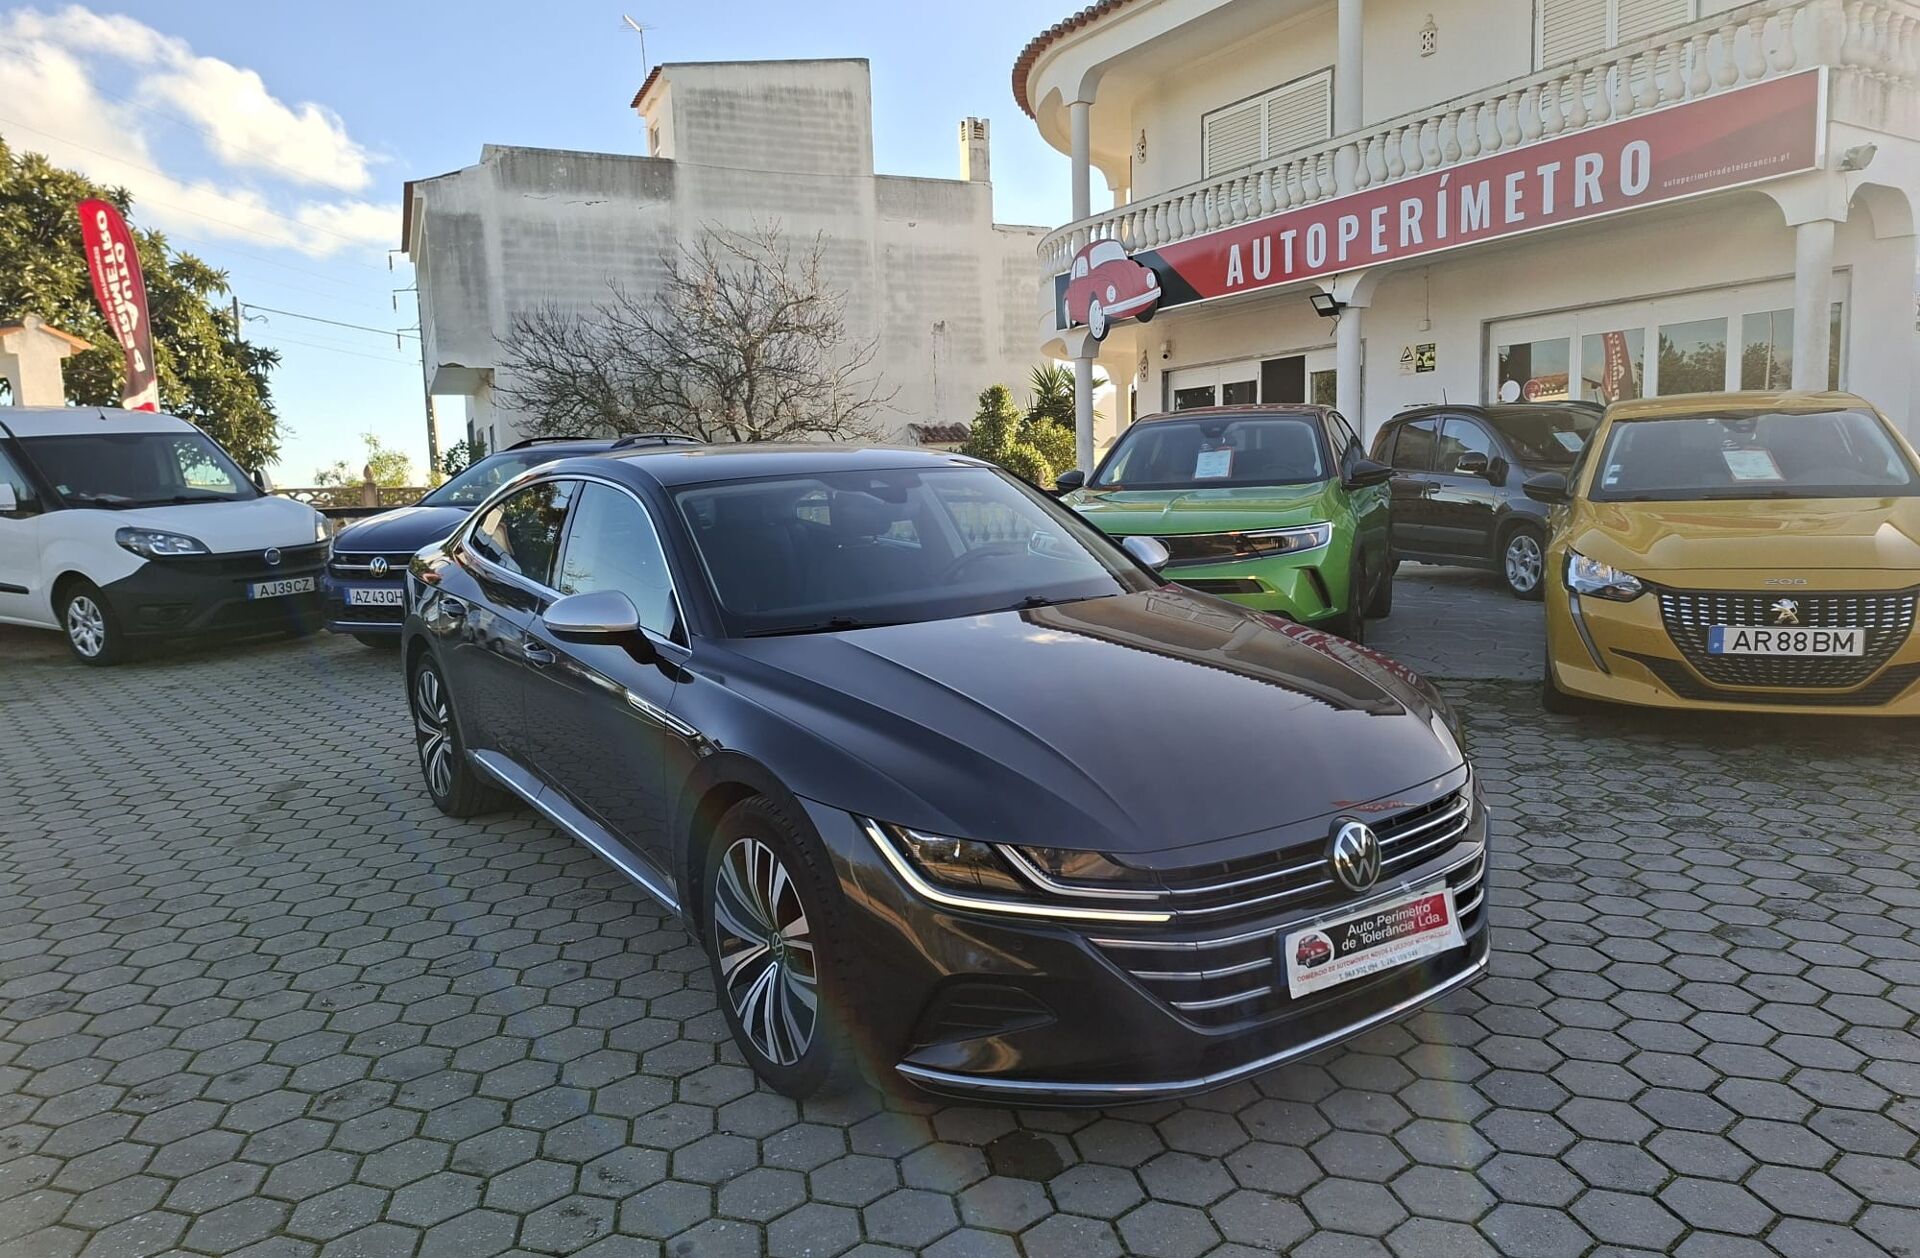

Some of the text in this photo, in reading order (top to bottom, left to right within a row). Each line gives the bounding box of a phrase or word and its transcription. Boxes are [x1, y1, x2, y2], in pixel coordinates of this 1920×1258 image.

[1226, 138, 1650, 287] AUTOPERÍMETRO
[1341, 939, 1356, 951] de
[1360, 921, 1415, 944] Tolerância
[1418, 913, 1444, 927] Lda.
[1347, 921, 1374, 936] Auto
